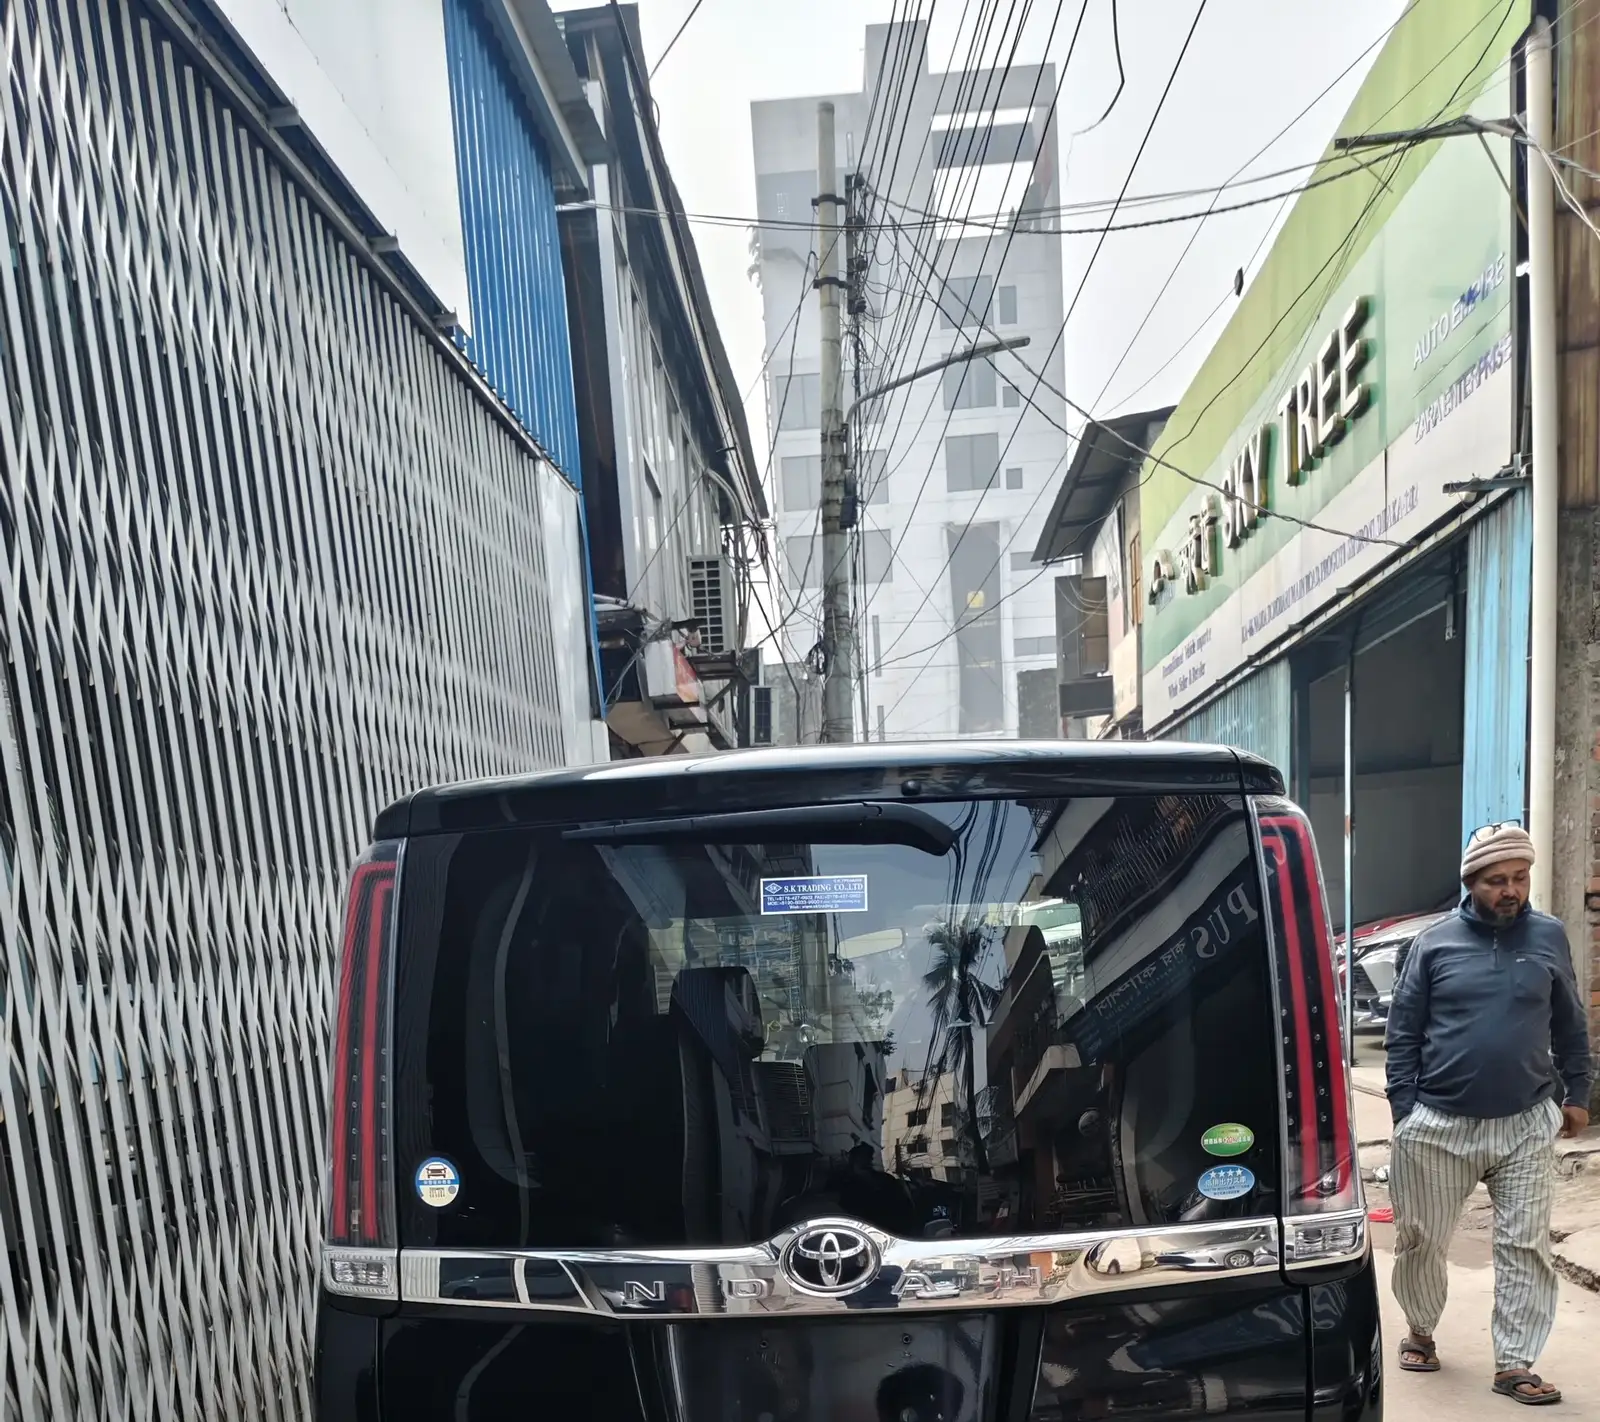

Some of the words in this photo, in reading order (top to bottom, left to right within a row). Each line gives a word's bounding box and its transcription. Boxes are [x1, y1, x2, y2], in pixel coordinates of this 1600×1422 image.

[1413, 312, 1450, 371] AUTO
[1221, 421, 1270, 549] SKY
[1277, 294, 1370, 487] TREE
[1414, 392, 1443, 444] ZARA
[1444, 330, 1512, 417] ENTERPRISE
[798, 883, 831, 892] TRADING
